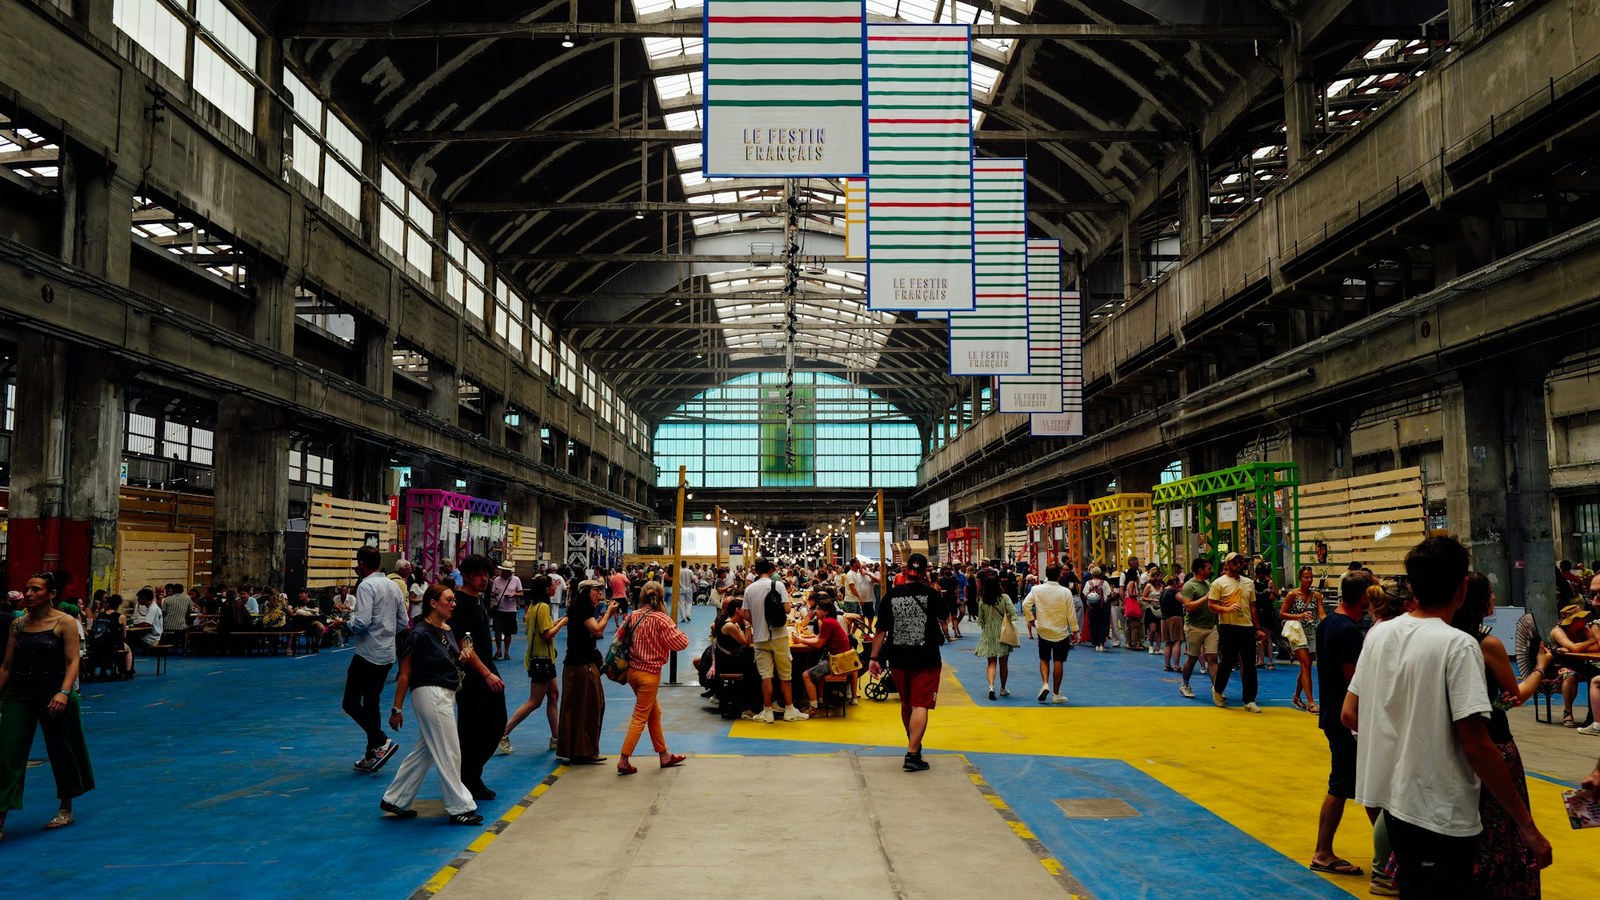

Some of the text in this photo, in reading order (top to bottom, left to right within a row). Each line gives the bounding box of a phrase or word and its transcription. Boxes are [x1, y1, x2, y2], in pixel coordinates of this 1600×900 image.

[744, 128, 825, 144] LE FESTIN
[745, 145, 824, 163] FRANÇAIS
[893, 278, 948, 288] LE FESTIN
[968, 351, 1009, 359] LE FESTIN
